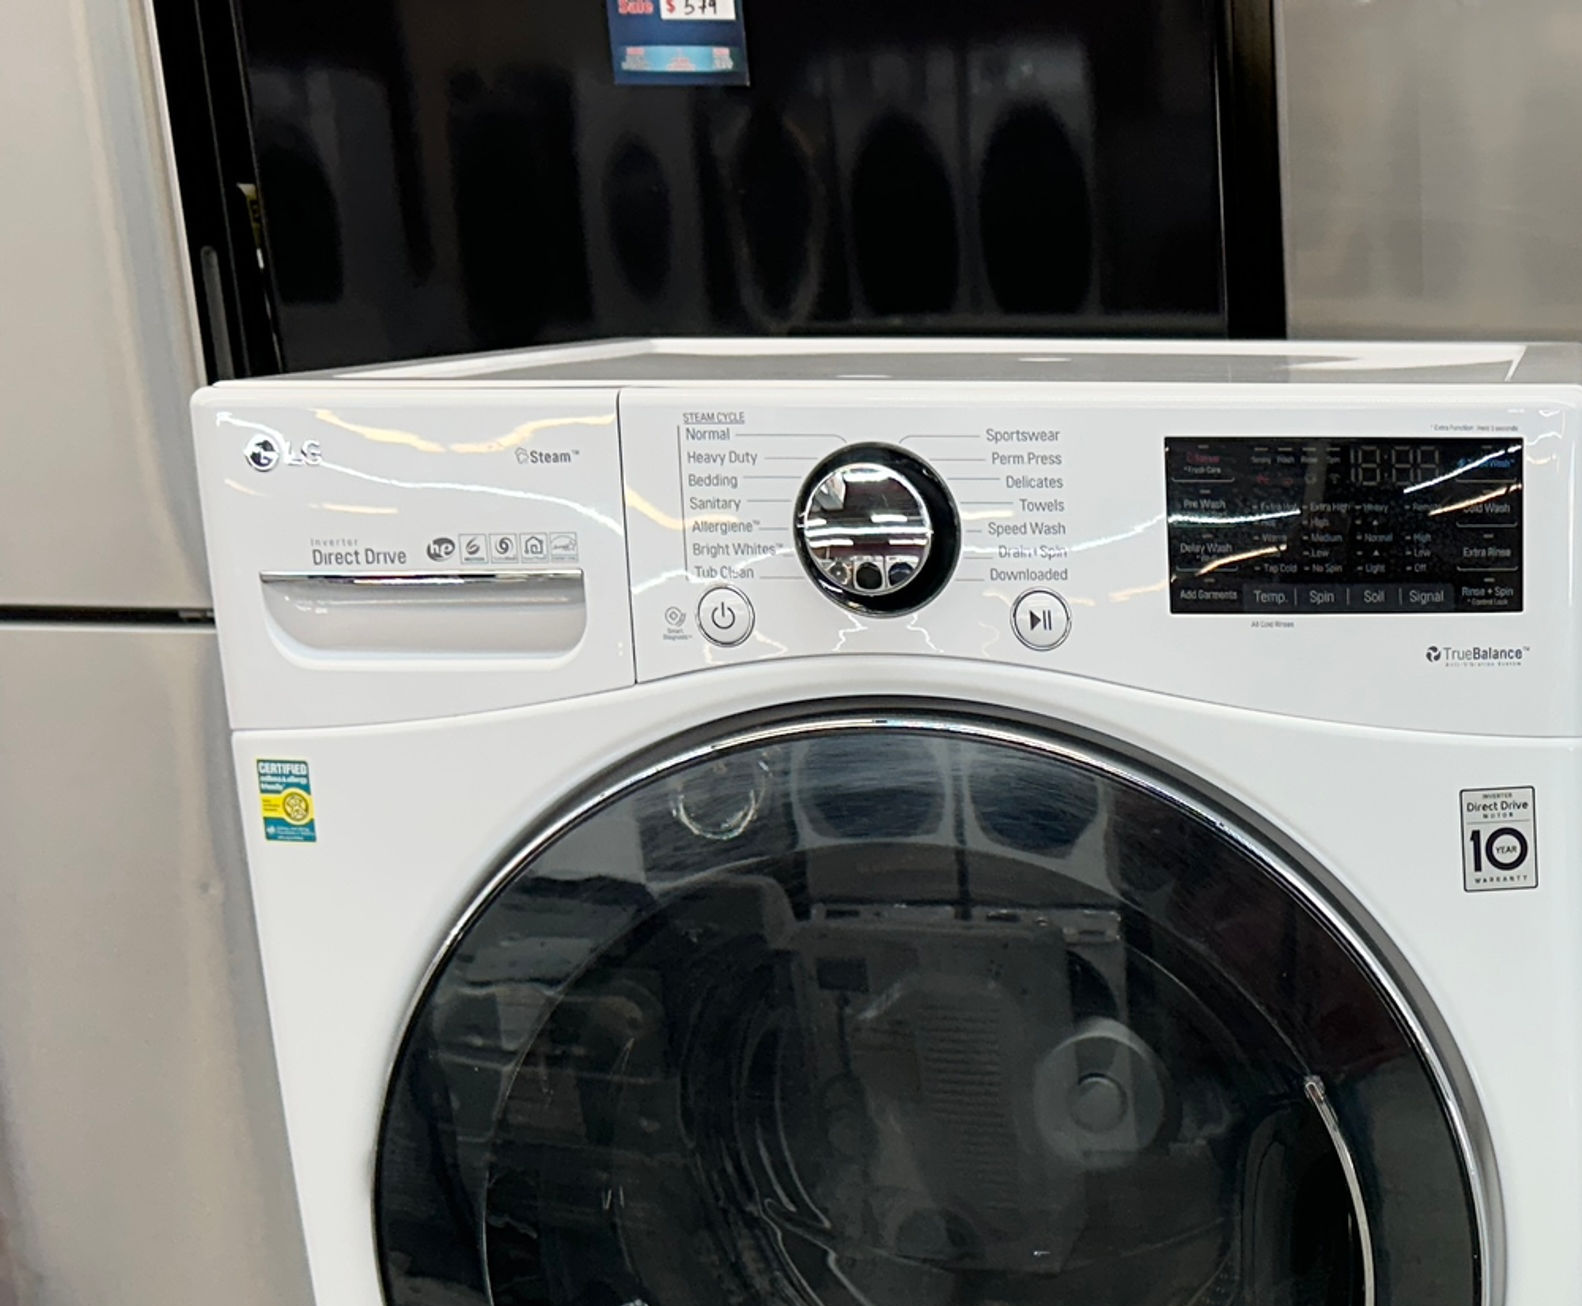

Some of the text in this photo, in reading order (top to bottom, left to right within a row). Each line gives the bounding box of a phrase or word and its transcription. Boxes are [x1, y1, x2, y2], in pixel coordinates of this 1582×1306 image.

[682, 411, 745, 424] STEAM CYCLE
[685, 427, 731, 441] Normal
[985, 428, 1061, 444] Sportswear
[687, 450, 758, 466] Heavy Duty
[688, 473, 738, 489] Bedding
[1005, 474, 1064, 489] Delicates
[689, 496, 741, 511] Sanitary
[1018, 498, 1065, 513] Towels
[1484, 502, 1511, 513] Wash
[987, 521, 1067, 538] Speed Wash
[692, 542, 730, 558] Bright
[1180, 542, 1234, 554] Delay Wash
[1463, 546, 1486, 557] Extra
[312, 548, 407, 566] Direct Drive
[694, 565, 717, 579] Tub
[989, 567, 1069, 582] Downloaded
[1180, 589, 1238, 600] Add Garments
[1309, 590, 1336, 606] Spin
[1363, 590, 1386, 603] Soil
[1409, 589, 1445, 606] Signal
[1461, 586, 1486, 597] Rinse
[1494, 586, 1514, 599] Spin
[260, 762, 307, 775] CERTIFIED
[1466, 800, 1529, 812] Direct Drive
[1470, 827, 1529, 872] 10
[1495, 845, 1518, 854] YEAR
[1475, 875, 1528, 883] WARRANTY
